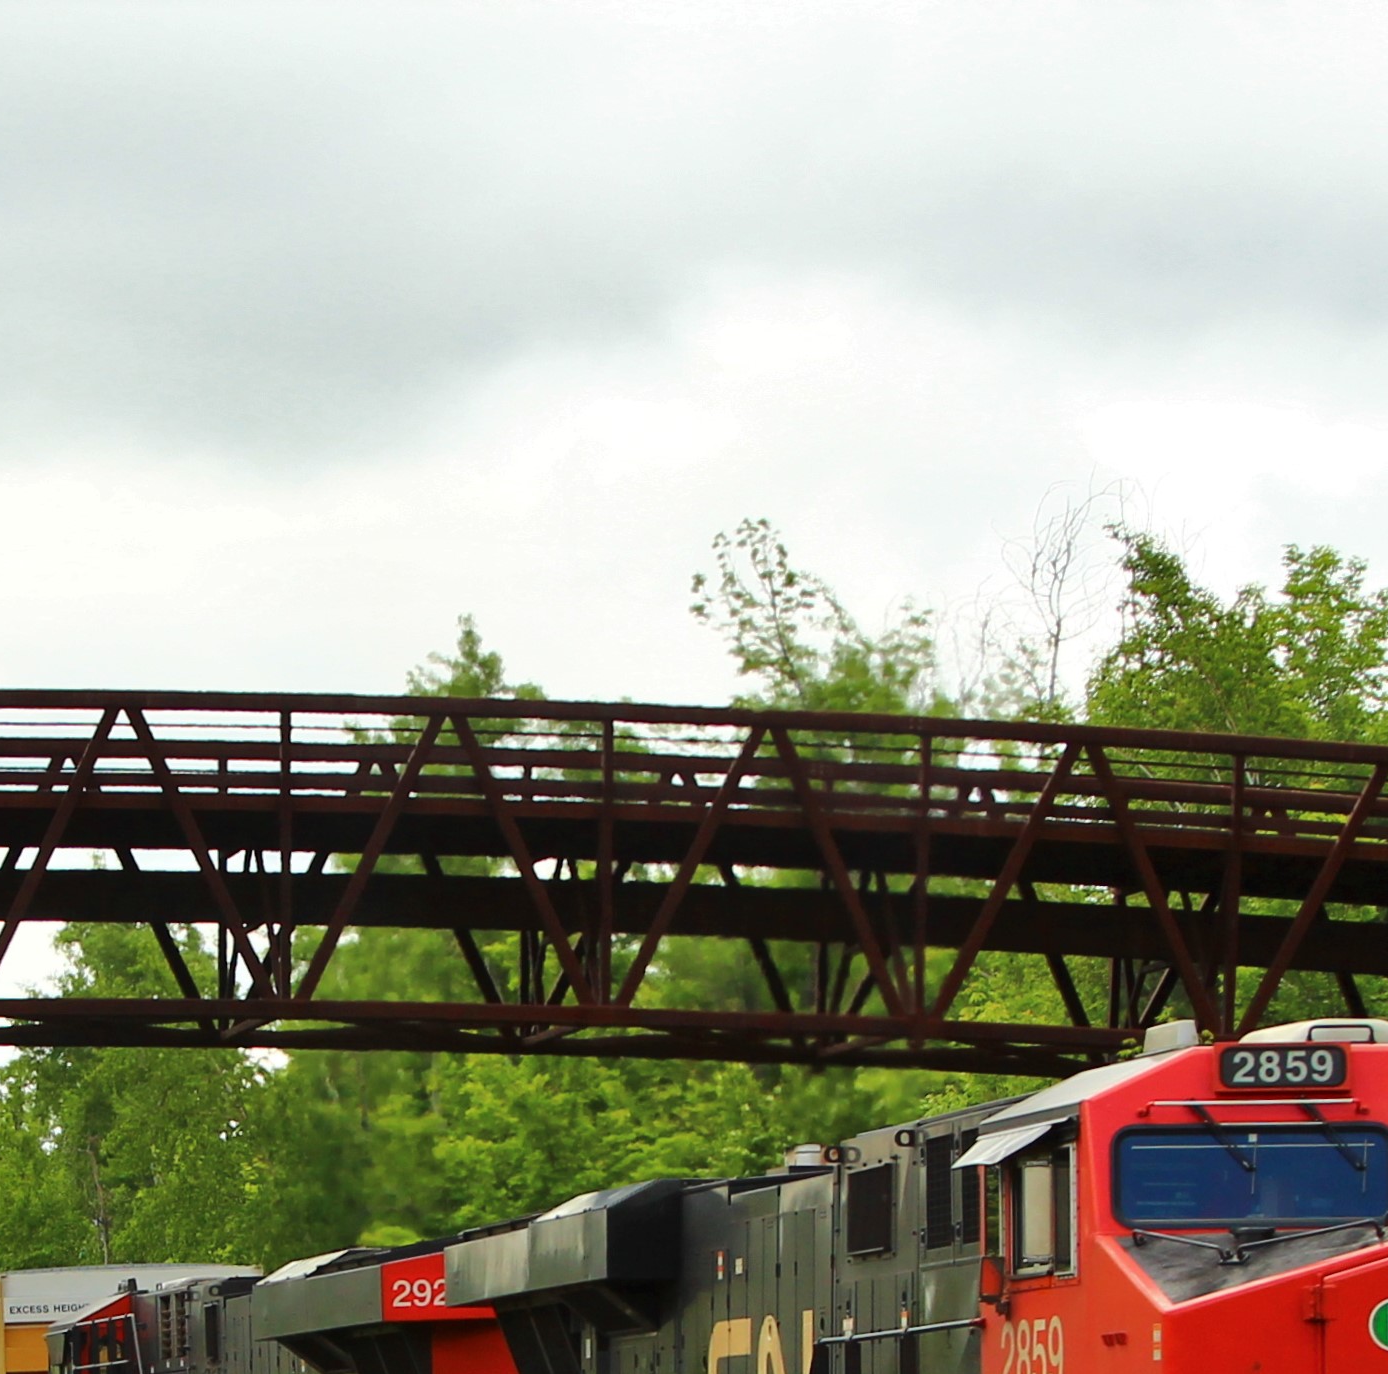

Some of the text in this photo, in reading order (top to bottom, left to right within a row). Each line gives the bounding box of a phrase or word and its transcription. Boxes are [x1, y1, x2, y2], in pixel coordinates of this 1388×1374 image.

[1233, 1050, 1333, 1083] 2859
[393, 1278, 446, 1307] 292
[9, 1302, 90, 1314] EXCESS HEIG
